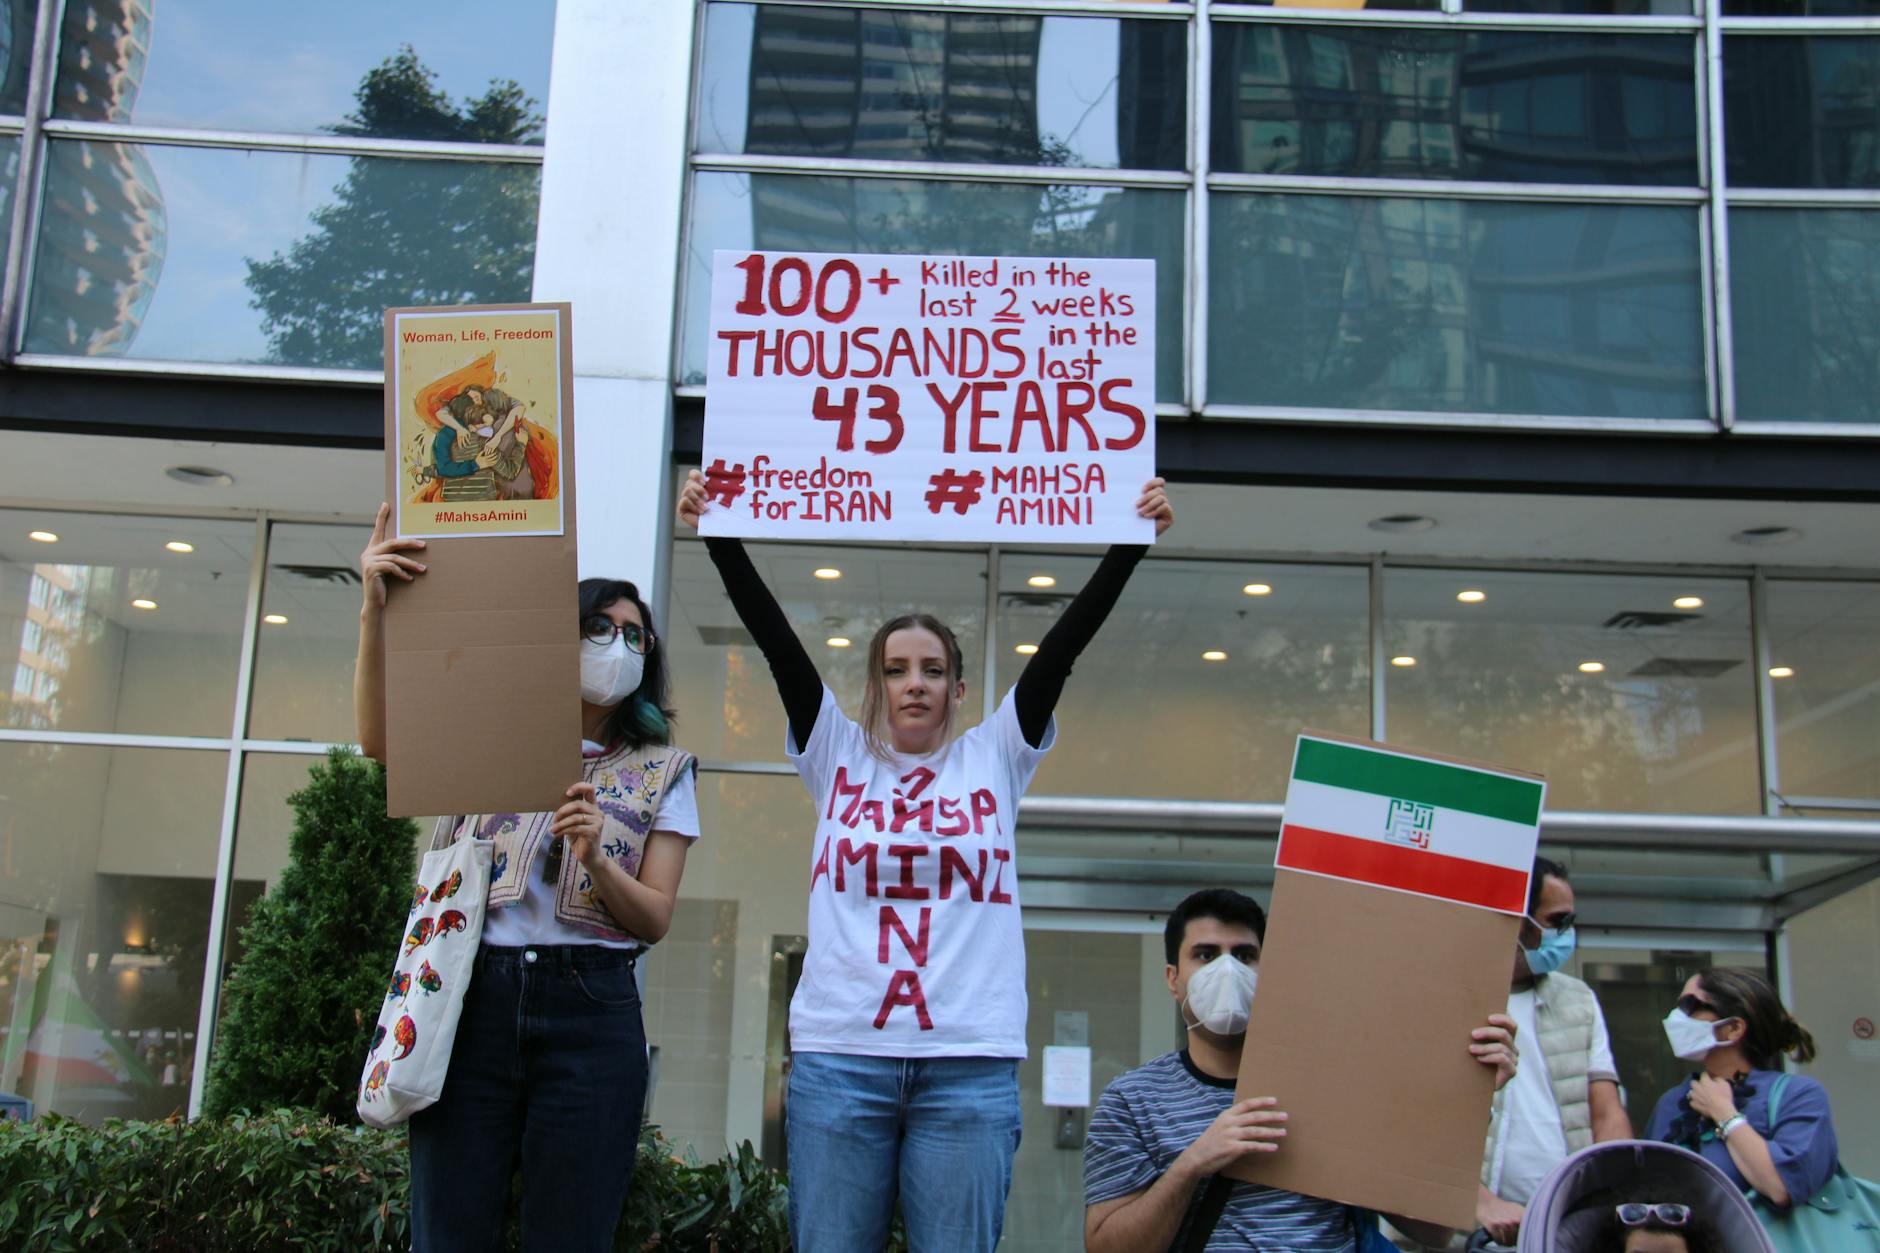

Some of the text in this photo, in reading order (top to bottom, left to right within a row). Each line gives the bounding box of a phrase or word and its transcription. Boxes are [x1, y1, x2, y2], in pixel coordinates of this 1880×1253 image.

[735, 254, 900, 324] 100+
[1011, 266, 1036, 286] in
[1048, 263, 1091, 287] the
[920, 287, 1135, 319] last 2 weeks
[402, 328, 554, 345] Woman, Life, Freedom
[717, 323, 1137, 380] THOUSANDS in the
[1038, 347, 1103, 380] last
[812, 378, 1146, 454] 43 YEARS
[434, 509, 528, 523] #MahsaAmini
[996, 496, 1093, 526] AMINI
[811, 835, 1012, 905] AMINI
